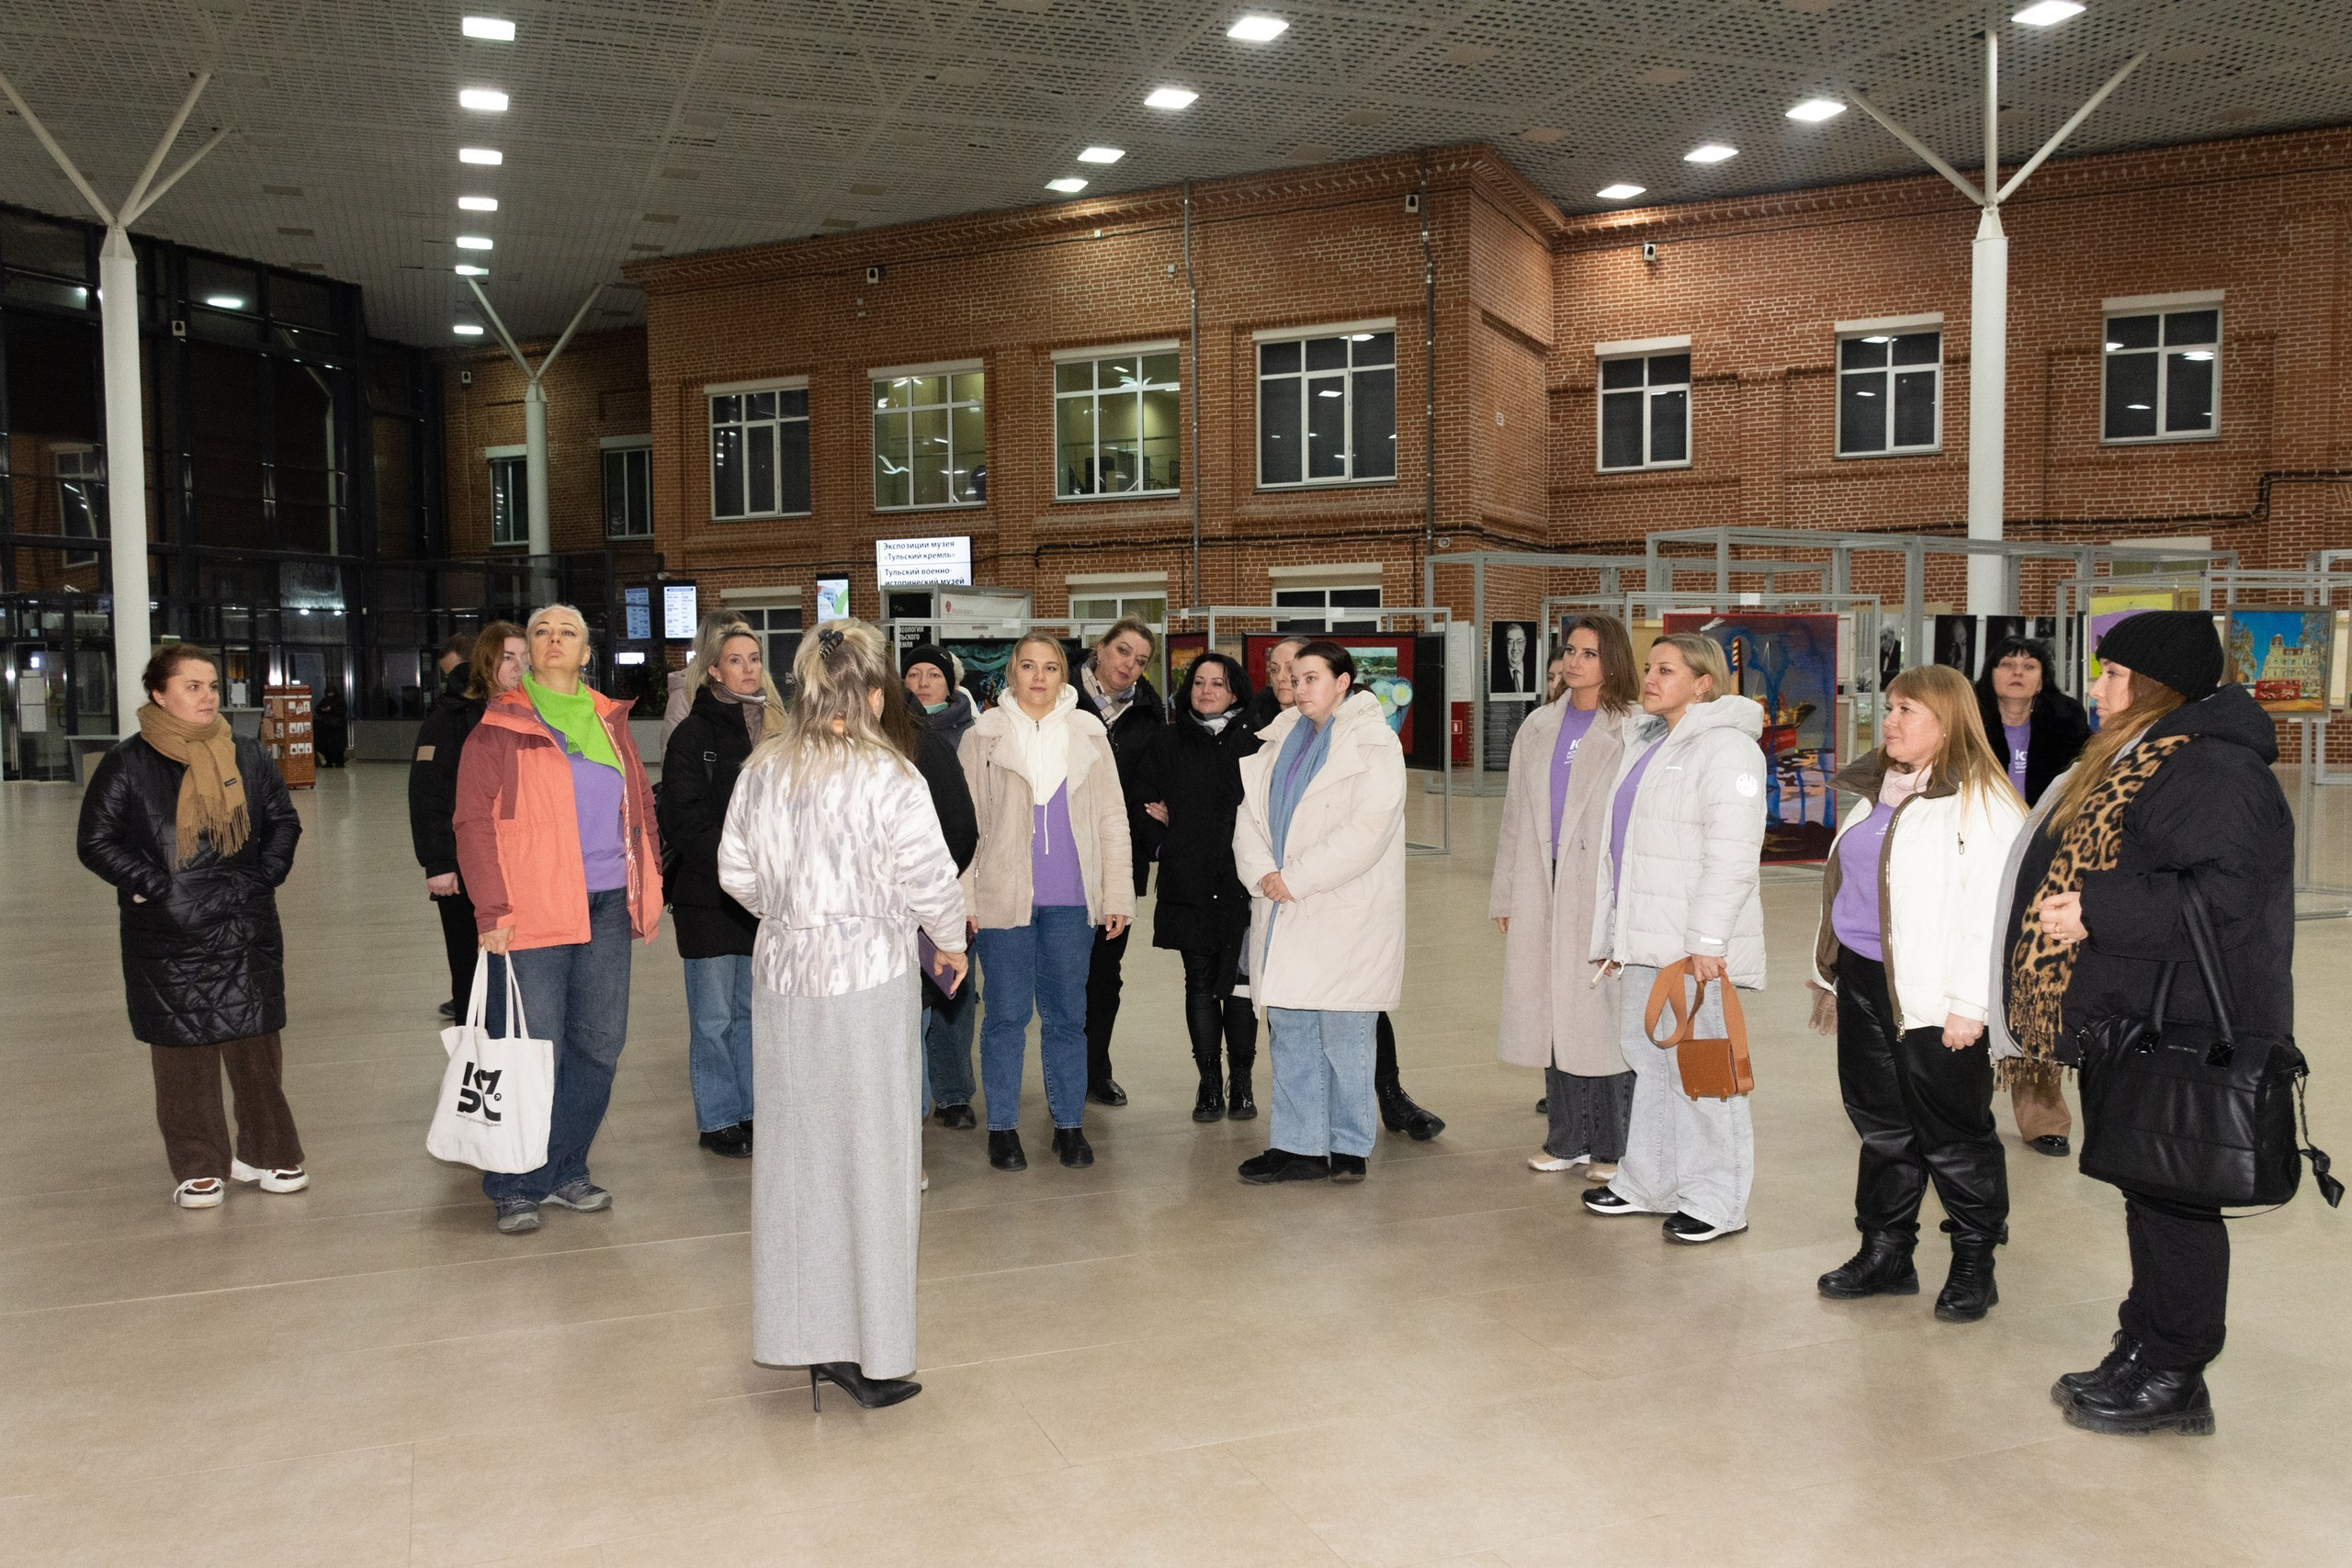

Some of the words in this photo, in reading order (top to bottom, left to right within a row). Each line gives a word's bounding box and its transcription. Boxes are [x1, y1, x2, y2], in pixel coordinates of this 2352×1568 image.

[883, 542, 930, 550] Экспозиции
[931, 541, 955, 549] музея
[884, 552, 922, 561] «Тульский
[923, 552, 956, 560] кремль»
[885, 568, 920, 577] Тульский
[941, 577, 965, 585] музей
